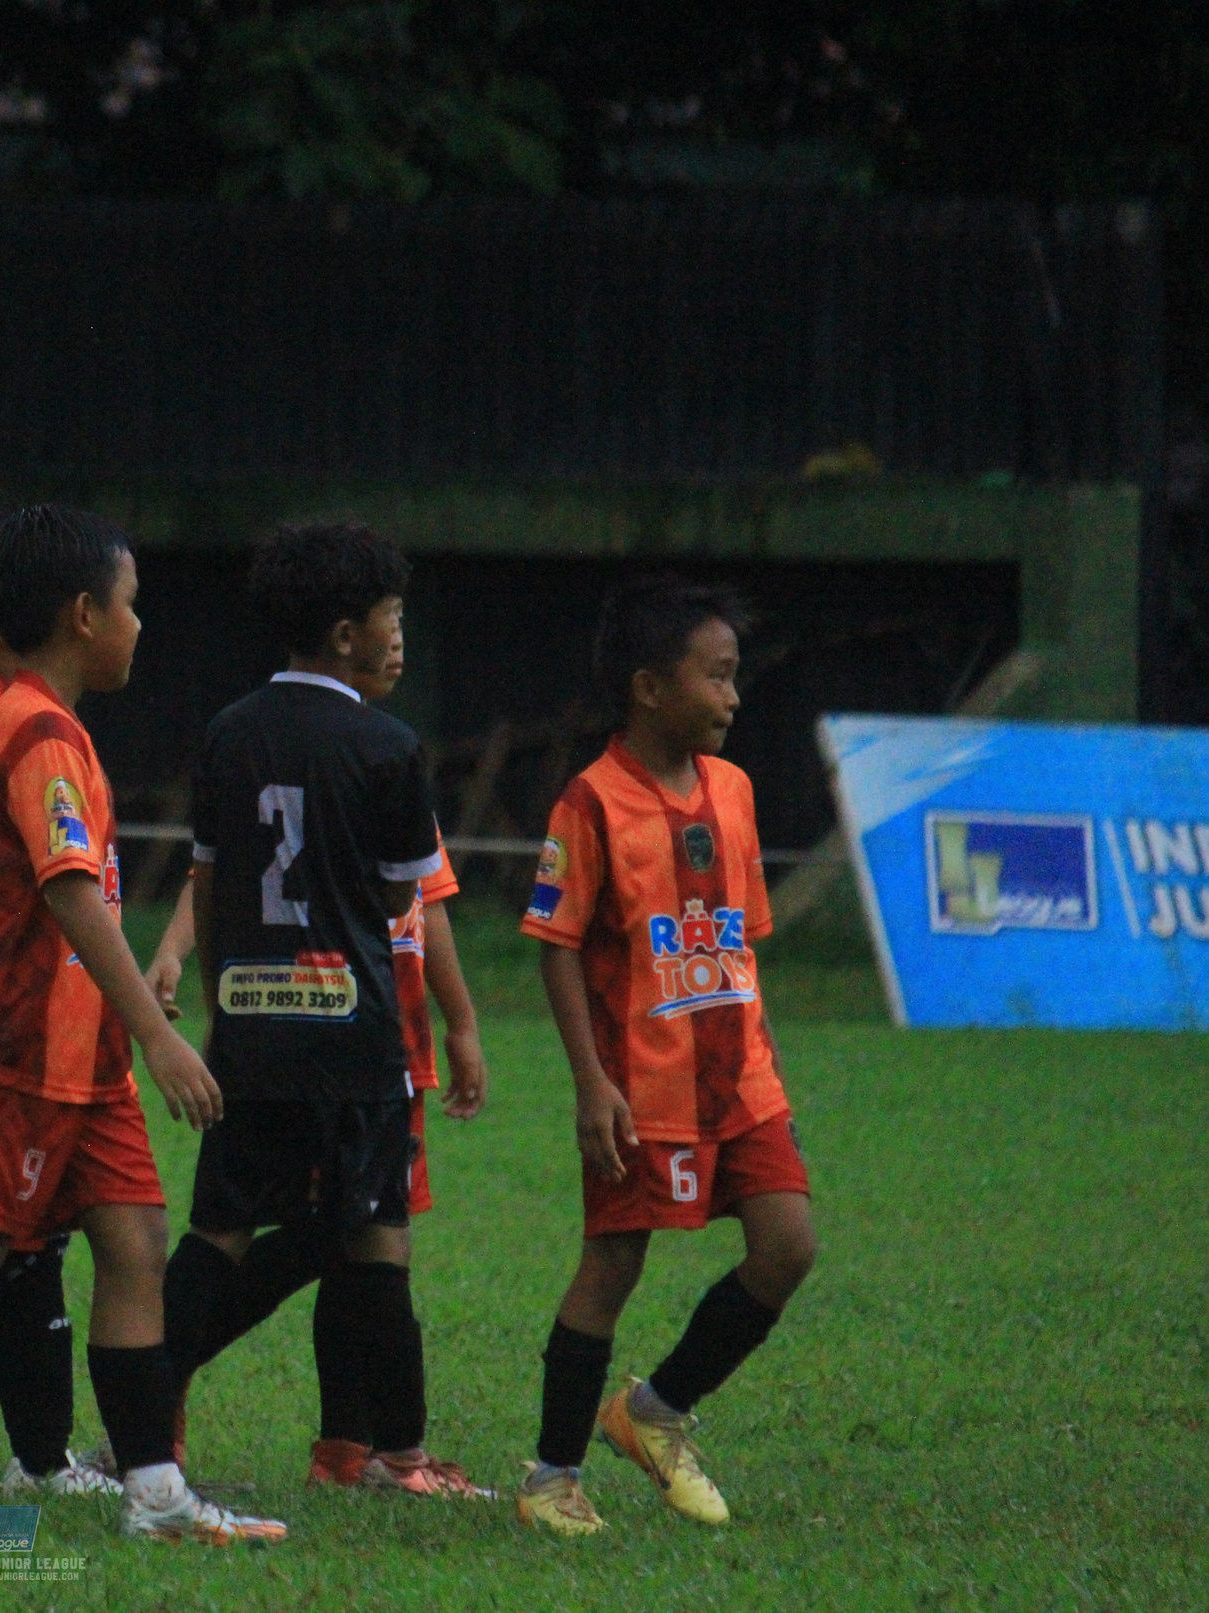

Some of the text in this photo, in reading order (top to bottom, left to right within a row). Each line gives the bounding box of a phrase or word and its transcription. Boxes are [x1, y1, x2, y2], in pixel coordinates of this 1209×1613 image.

[259, 785, 309, 927] 2
[230, 990, 347, 1009] 0812 9892 3209
[257, 973, 292, 984] PROMO
[16, 1148, 47, 1201] 9
[670, 1150, 698, 1201] 6
